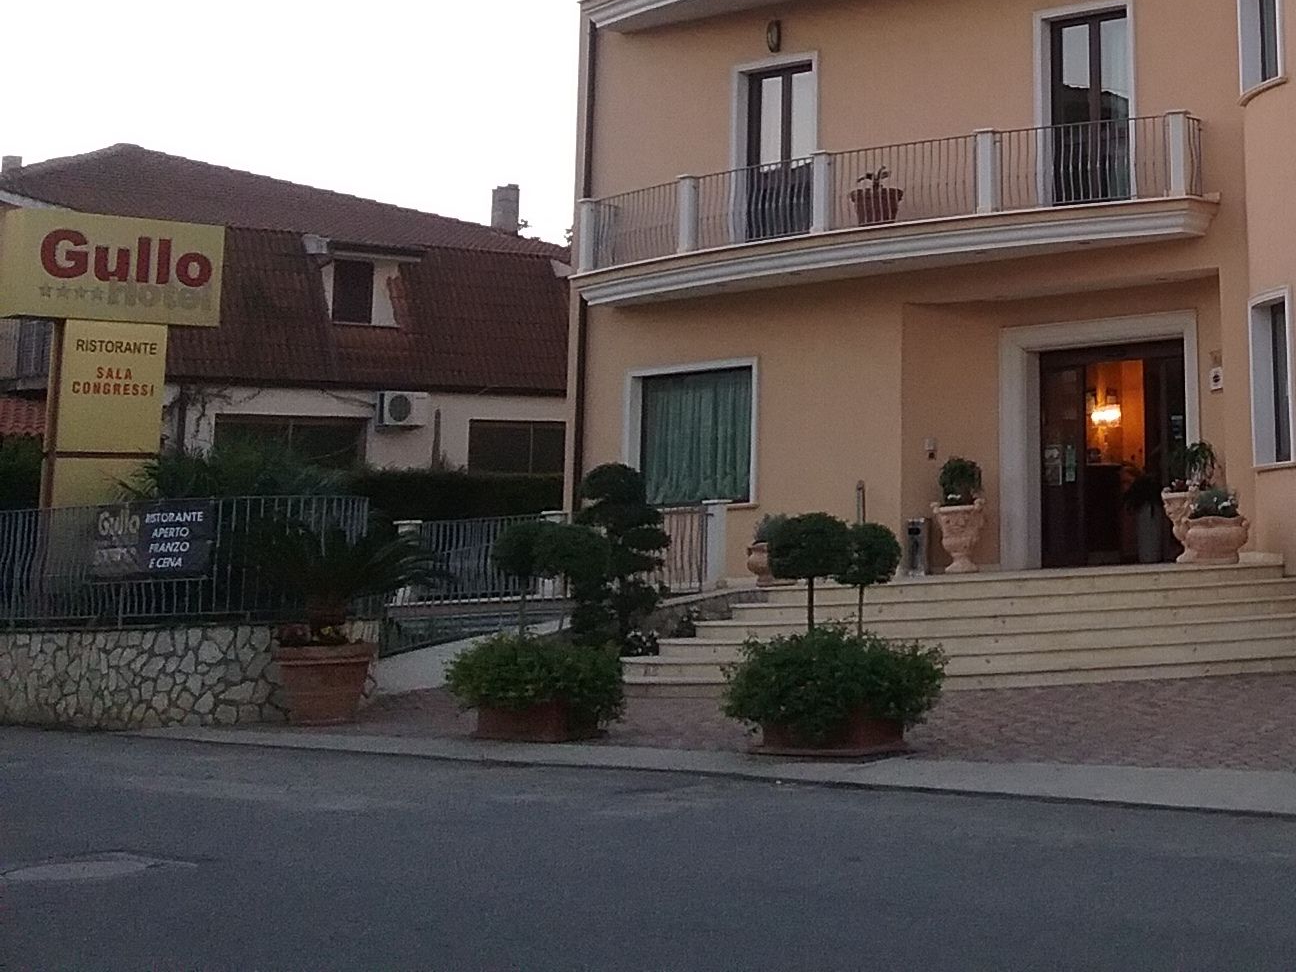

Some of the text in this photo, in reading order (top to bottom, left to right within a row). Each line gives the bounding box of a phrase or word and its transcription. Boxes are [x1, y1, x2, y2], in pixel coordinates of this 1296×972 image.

[40, 228, 213, 288] Gullo
[75, 338, 158, 356] RISTORANTE
[96, 366, 133, 381] SALA
[71, 381, 155, 397] CONGRESSI
[151, 527, 189, 538] APERTO
